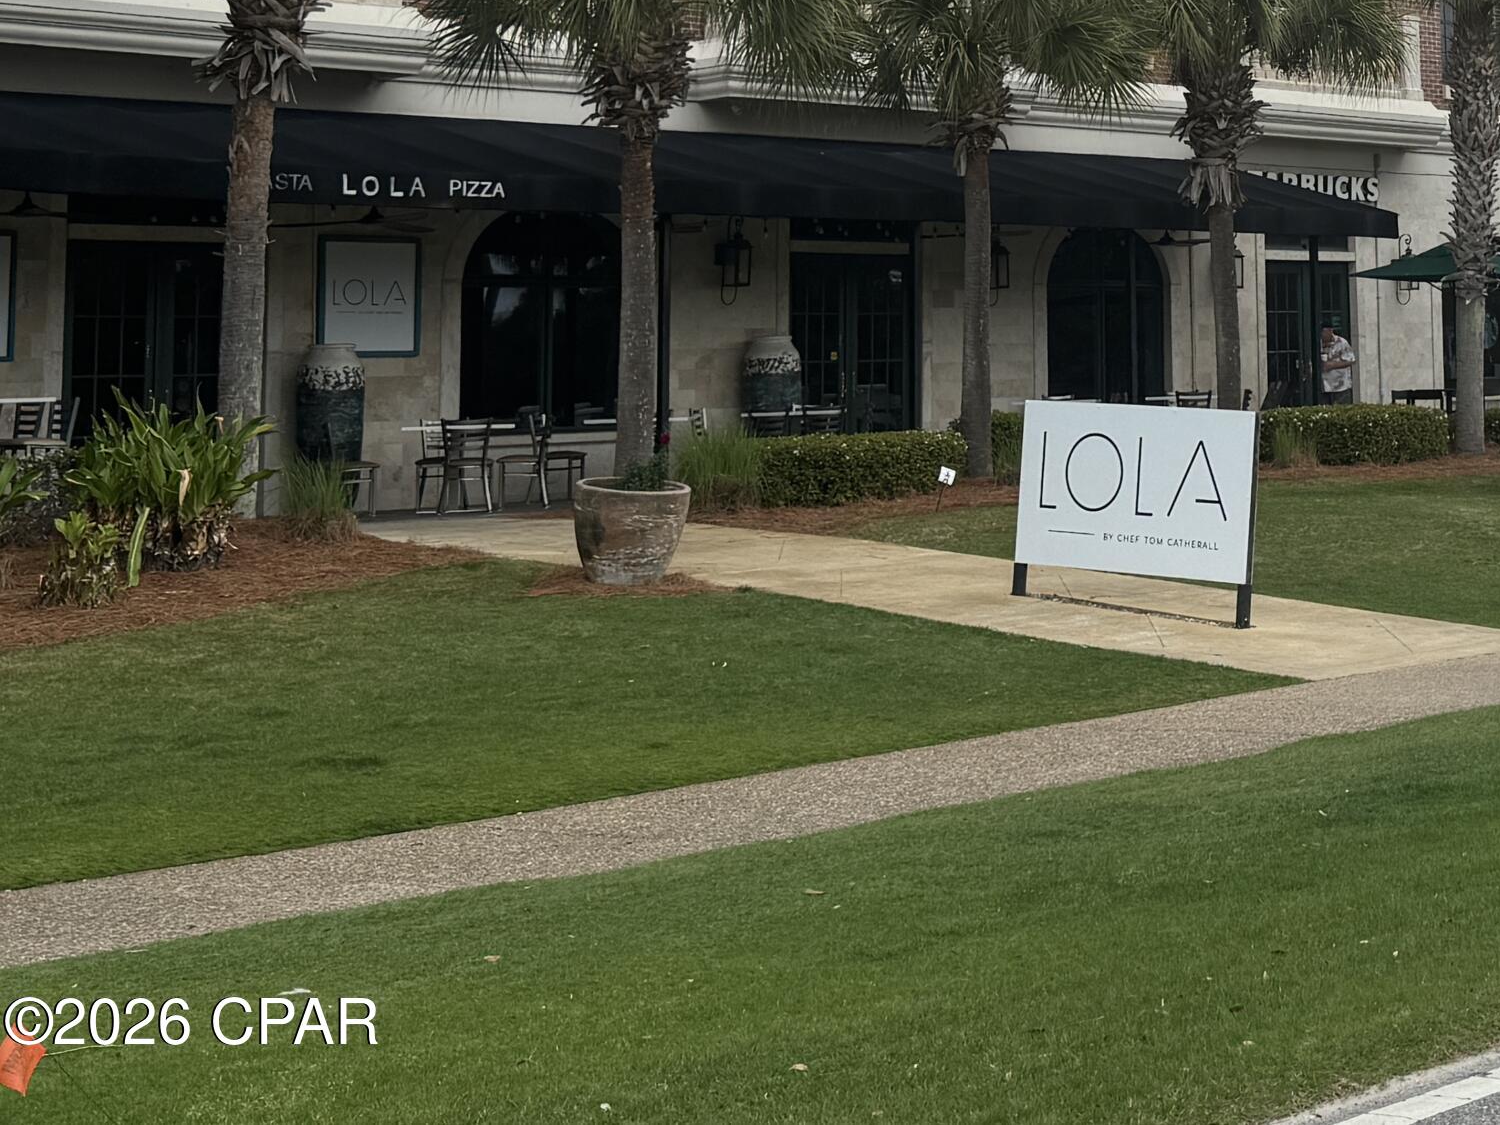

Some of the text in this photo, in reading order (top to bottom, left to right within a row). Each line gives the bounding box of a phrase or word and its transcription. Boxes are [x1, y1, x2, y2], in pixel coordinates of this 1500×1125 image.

[269, 173, 505, 198] STA LOLA PIZZA
[1247, 170, 1379, 202] RBUCKS
[332, 278, 406, 306] LOLA
[1039, 430, 1227, 522] LOLA
[1103, 532, 1219, 551] BY CHEF TOM CATHERALL
